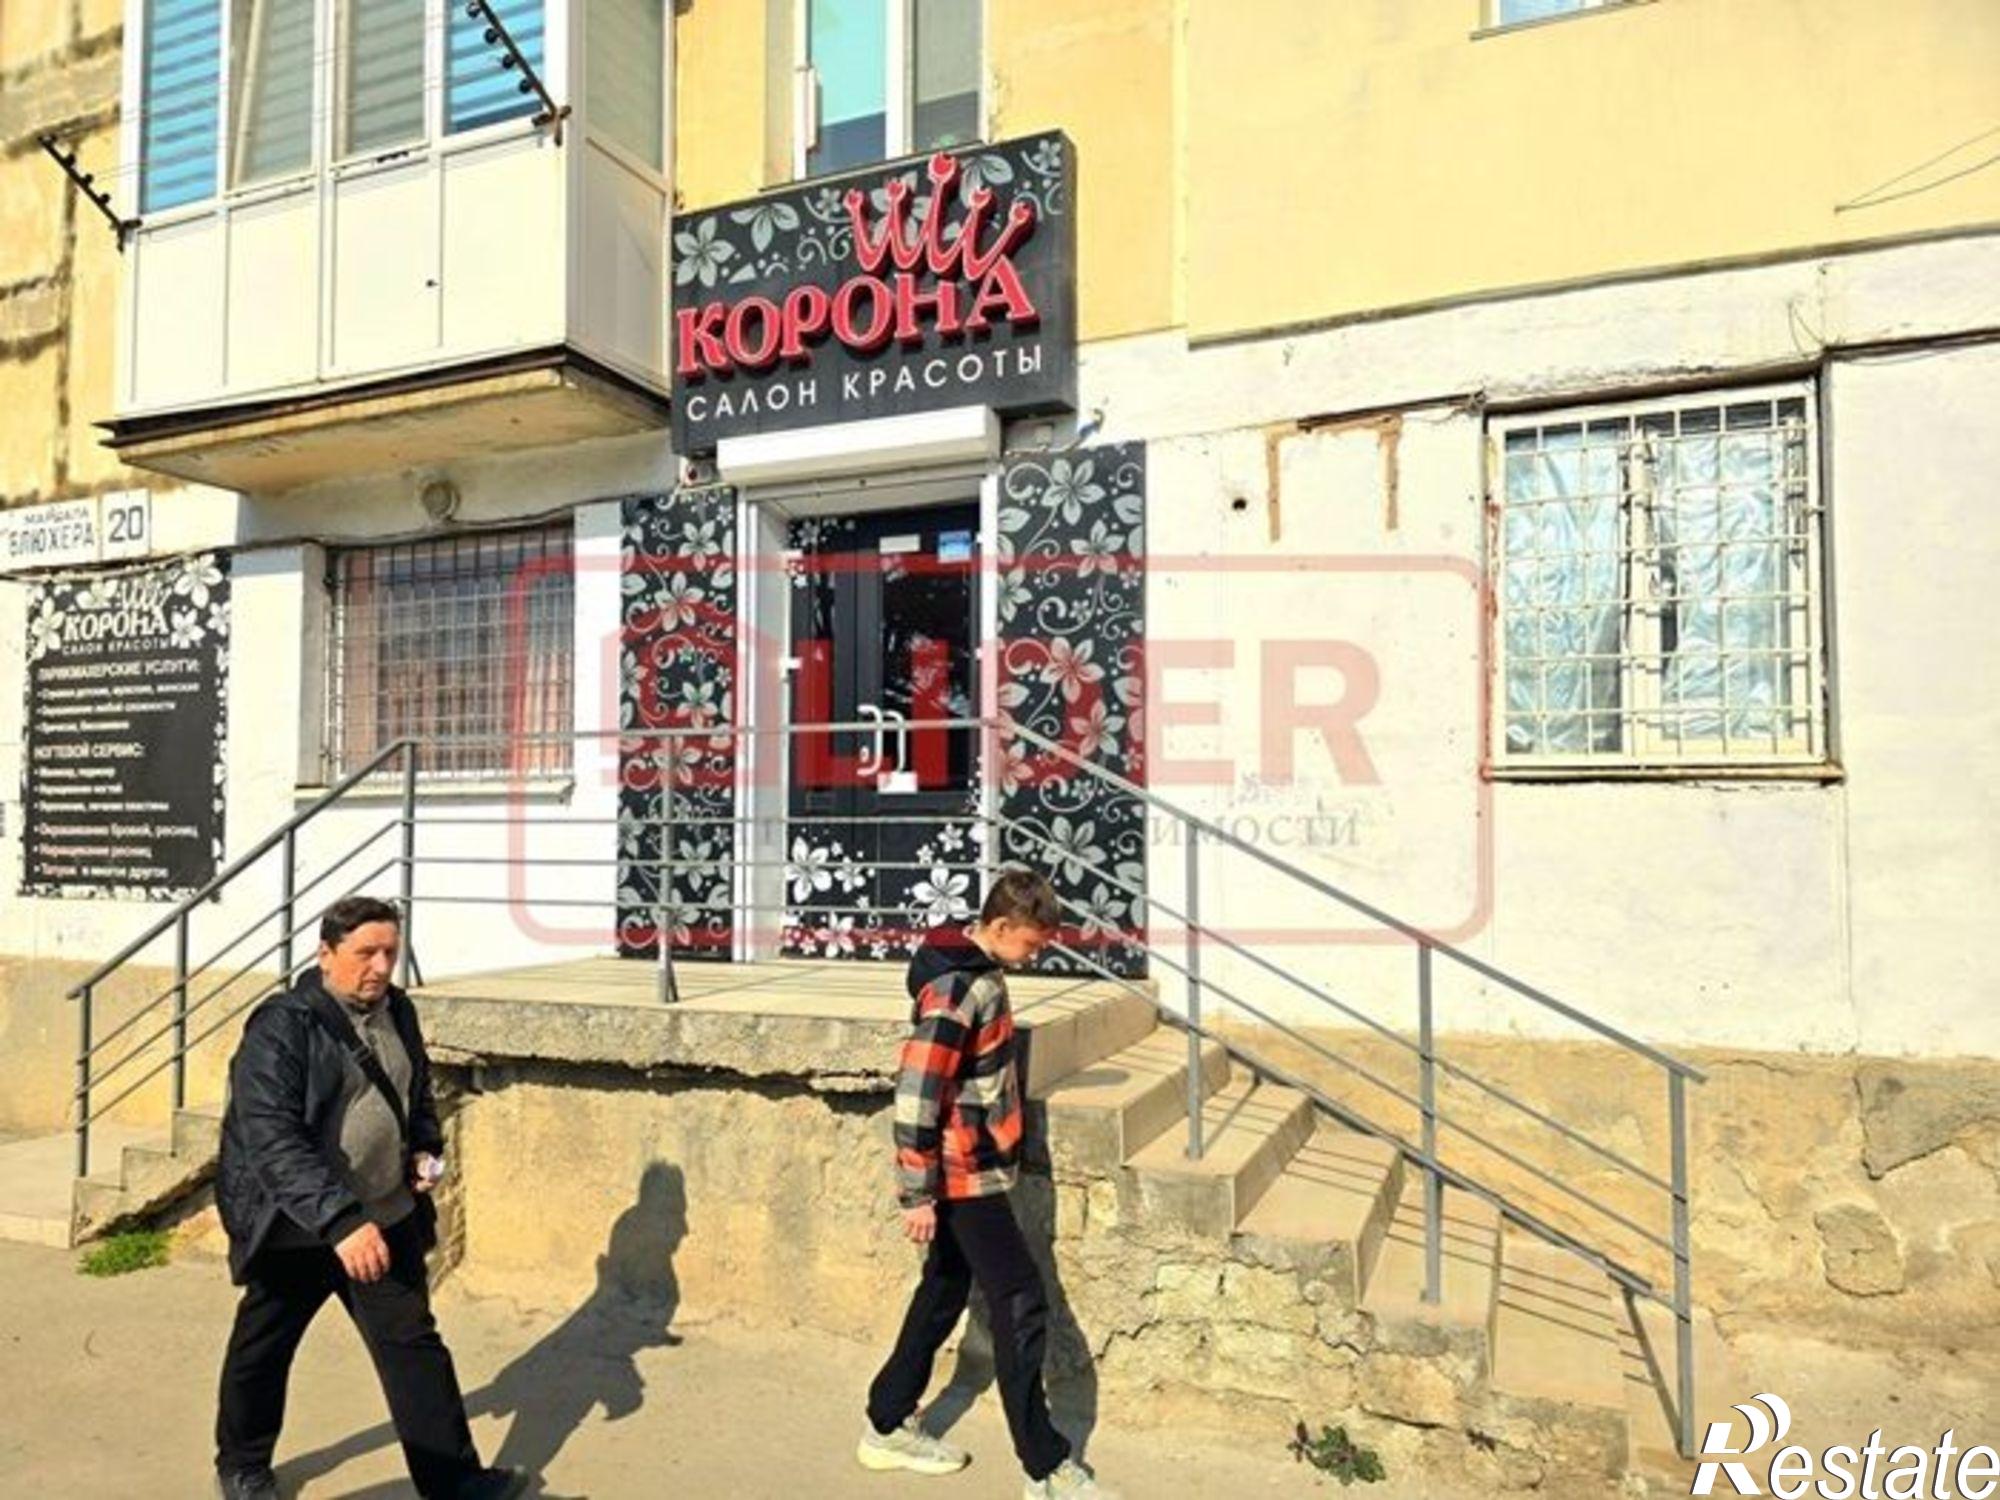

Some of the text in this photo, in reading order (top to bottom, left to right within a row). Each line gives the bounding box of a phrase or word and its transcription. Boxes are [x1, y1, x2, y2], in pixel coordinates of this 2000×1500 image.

[677, 253, 1038, 376] КОРОНА
[687, 344, 1042, 421] САЛОН КРАСОТЫ
[9, 522, 94, 557] БЛЮХЕРА
[107, 505, 144, 543] 20
[63, 605, 170, 641] КОРОНА
